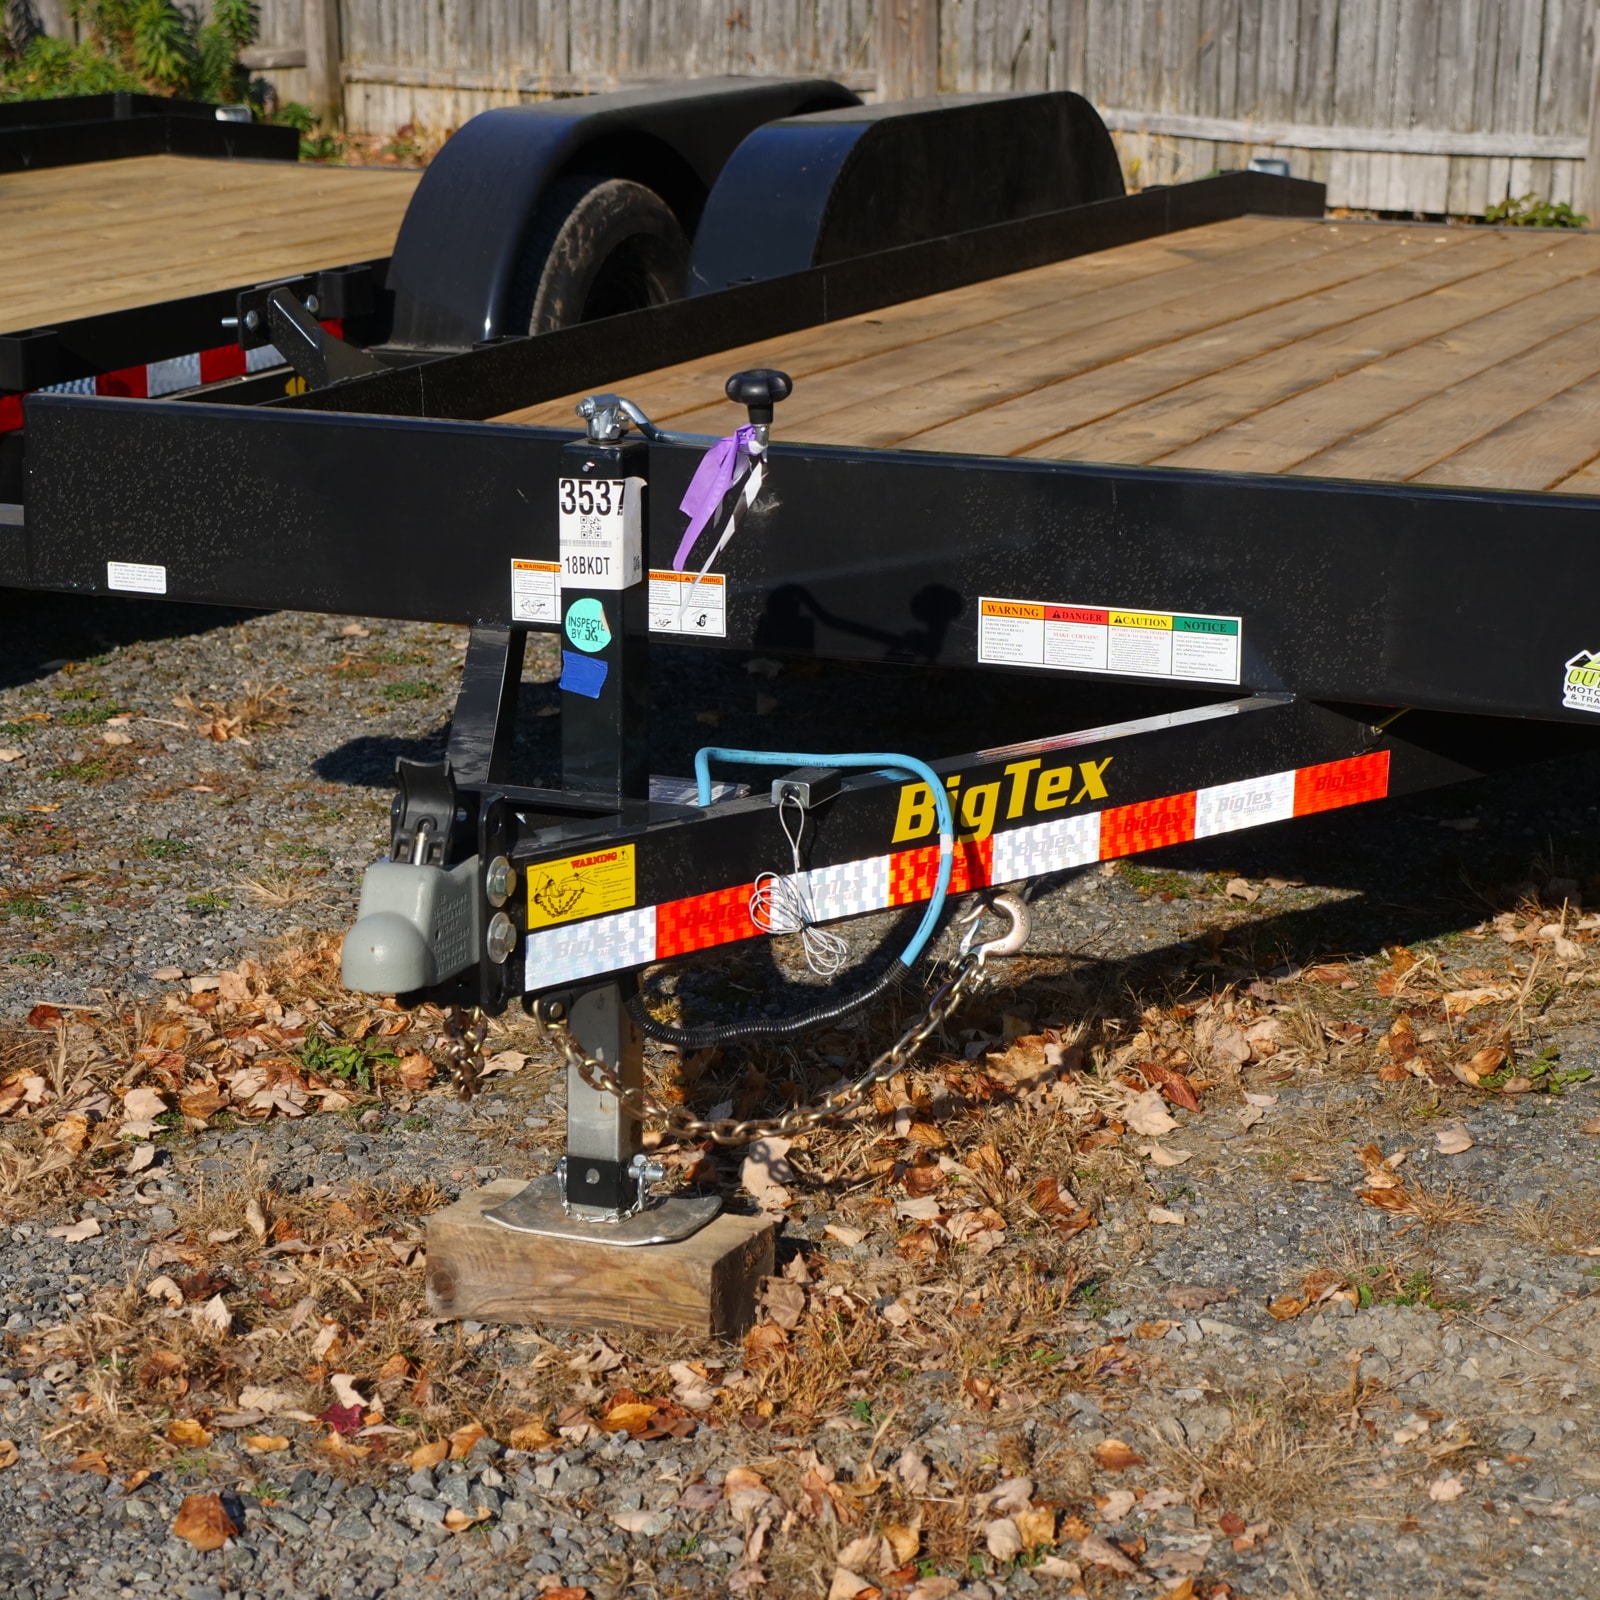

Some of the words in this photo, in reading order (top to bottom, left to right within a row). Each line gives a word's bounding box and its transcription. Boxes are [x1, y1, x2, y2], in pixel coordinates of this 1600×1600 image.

[560, 480, 624, 516] 3537
[523, 564, 552, 572] WARNING
[565, 556, 610, 575] 18BKDT
[649, 573, 678, 581] WARNING
[987, 604, 1039, 617] WARNING
[1062, 611, 1102, 622] DANGER
[1122, 616, 1168, 627] CAUTION
[1183, 620, 1227, 632] NOTICE
[571, 628, 581, 639] BY
[1314, 770, 1368, 792] BigTex
[891, 756, 1114, 844] BigTex
[1216, 790, 1274, 813] BigTex
[1243, 802, 1273, 816] TRAILERS
[1122, 811, 1182, 835] BigTex
[570, 851, 617, 870] WARNING
